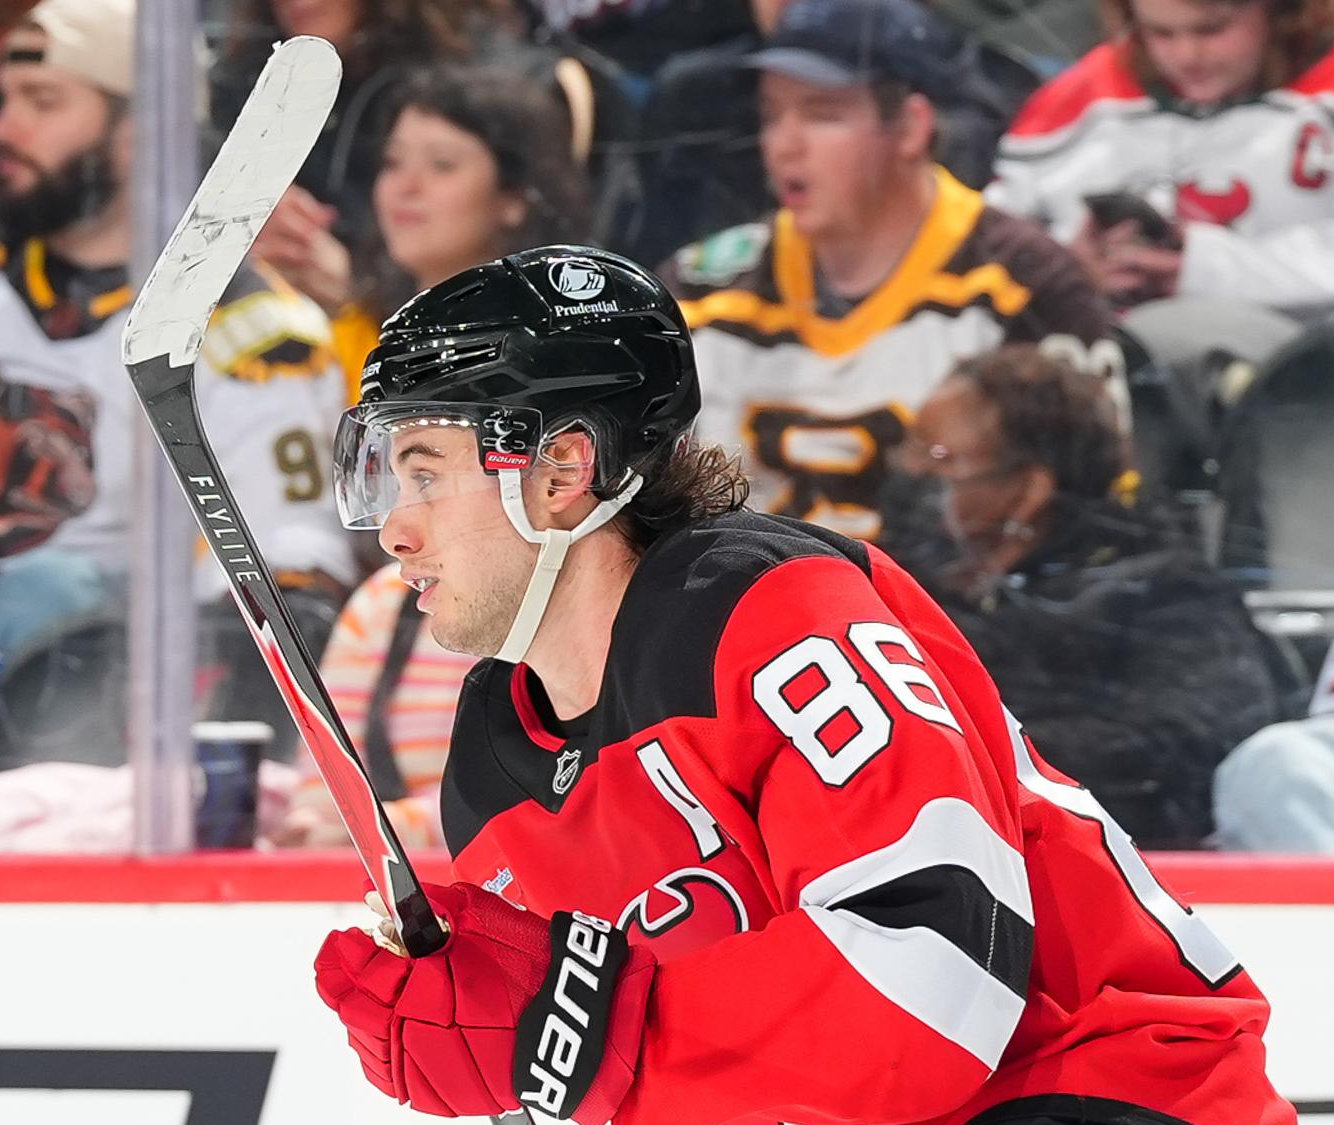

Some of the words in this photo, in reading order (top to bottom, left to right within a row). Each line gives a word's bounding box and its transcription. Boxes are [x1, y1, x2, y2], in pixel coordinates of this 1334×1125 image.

[554, 300, 619, 318] Prudential
[188, 474, 261, 583] FLYLITE
[752, 621, 965, 788] 86
